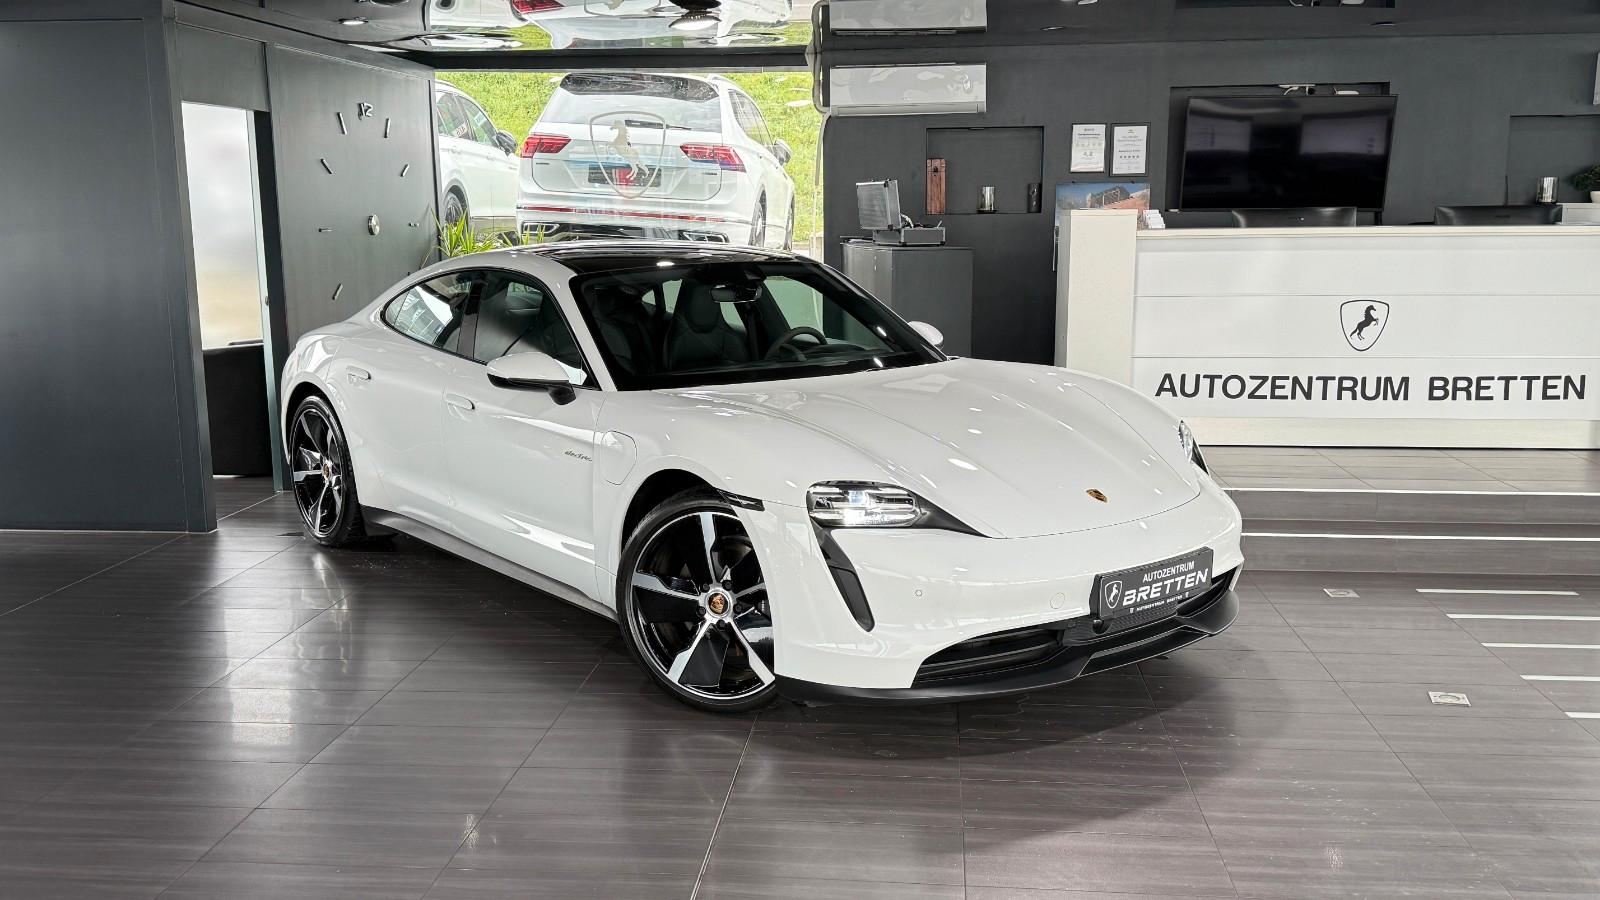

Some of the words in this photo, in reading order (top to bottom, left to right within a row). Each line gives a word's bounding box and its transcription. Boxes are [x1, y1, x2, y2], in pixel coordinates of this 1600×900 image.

[1155, 372, 1410, 402] AUTOZENTRUM
[1427, 374, 1586, 402] BRETTEN
[1142, 560, 1195, 583] AUTOZENTRUM
[1122, 568, 1209, 606] BRETTEN
